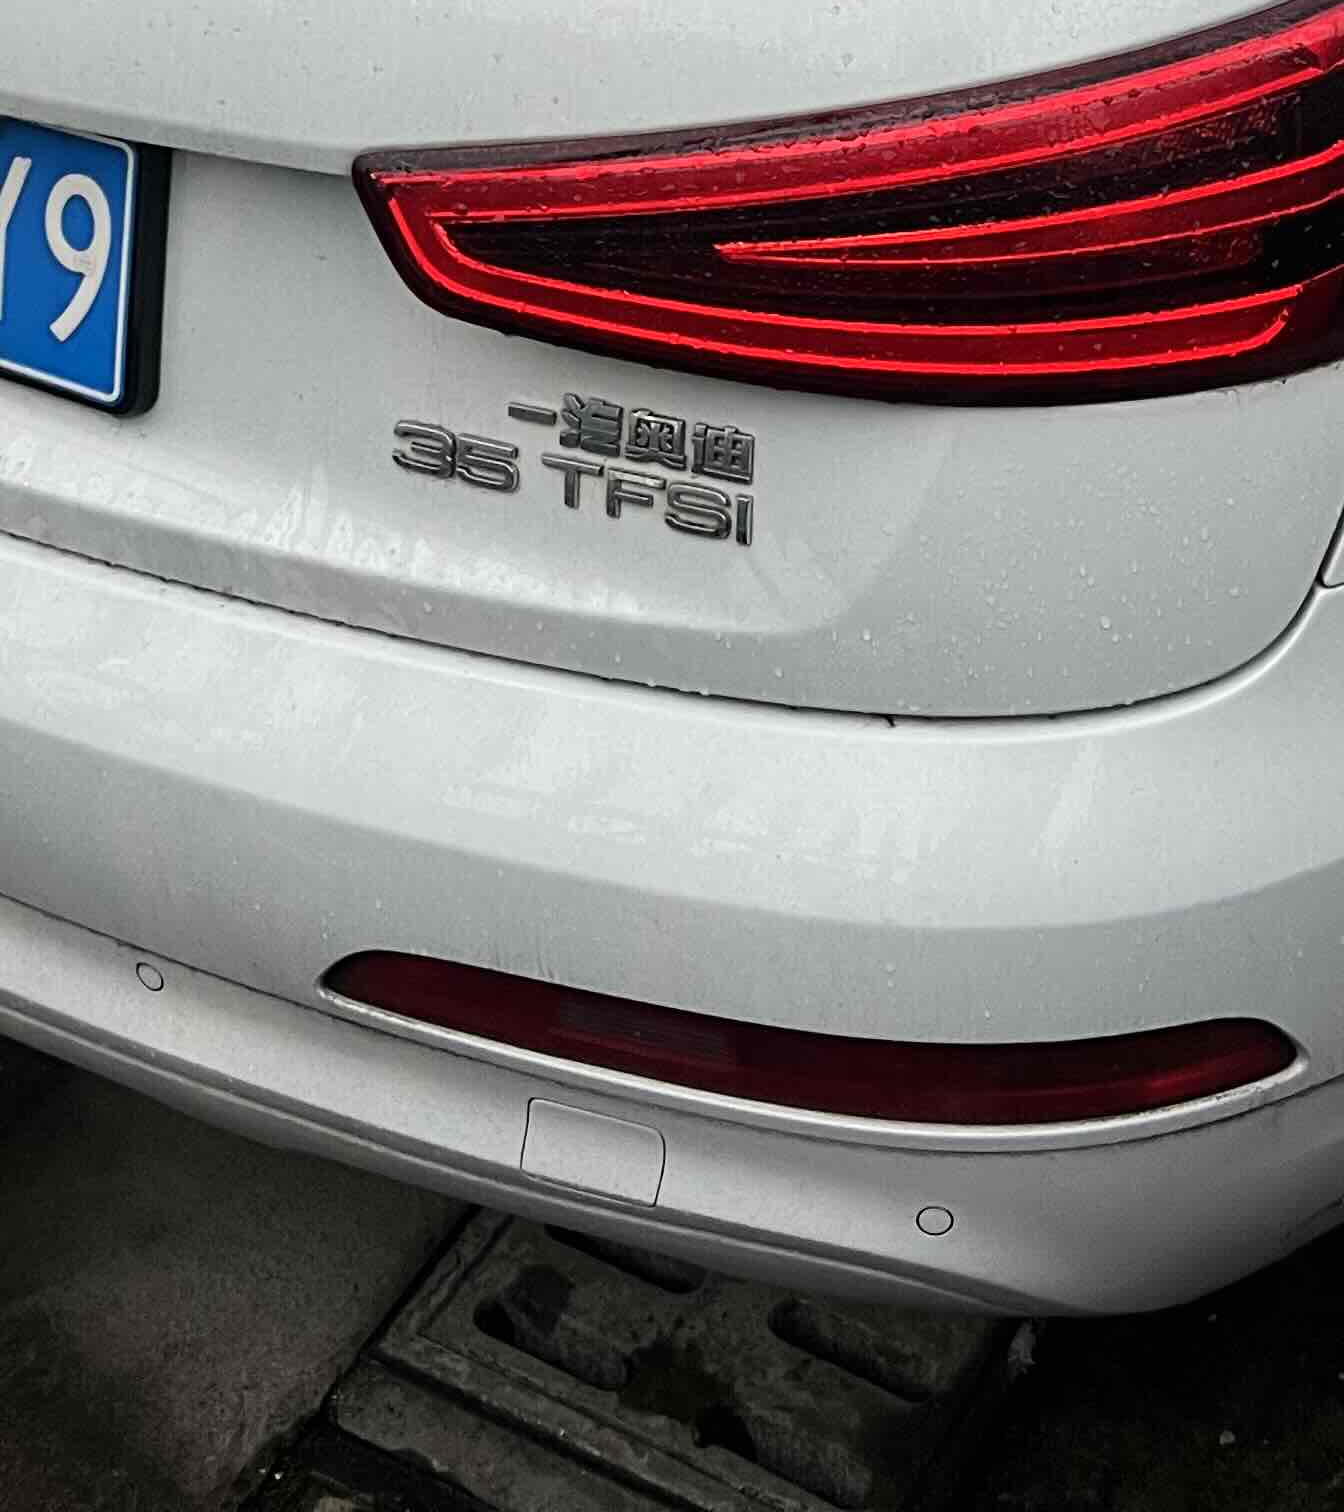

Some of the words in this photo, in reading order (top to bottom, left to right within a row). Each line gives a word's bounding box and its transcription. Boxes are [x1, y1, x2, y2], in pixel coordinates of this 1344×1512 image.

[392, 418, 521, 493] 35
[541, 451, 755, 547] TFSI
[507, 391, 756, 485] 一汽奥迪
